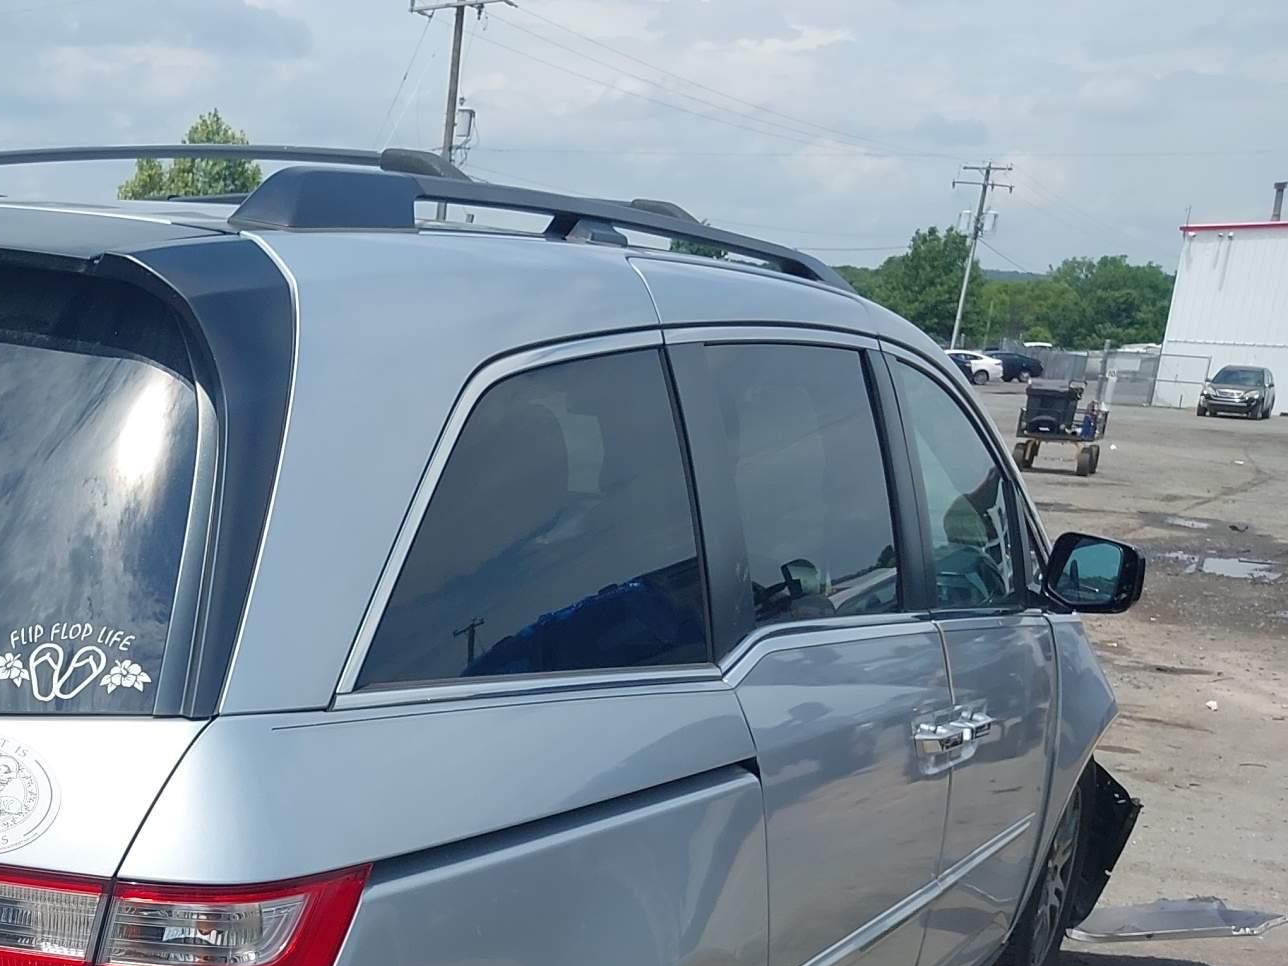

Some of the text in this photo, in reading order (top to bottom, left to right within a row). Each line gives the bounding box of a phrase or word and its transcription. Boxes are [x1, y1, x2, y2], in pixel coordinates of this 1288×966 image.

[10, 622, 136, 651] FLIP FLOP LIFE
[14, 745, 29, 757] IS
